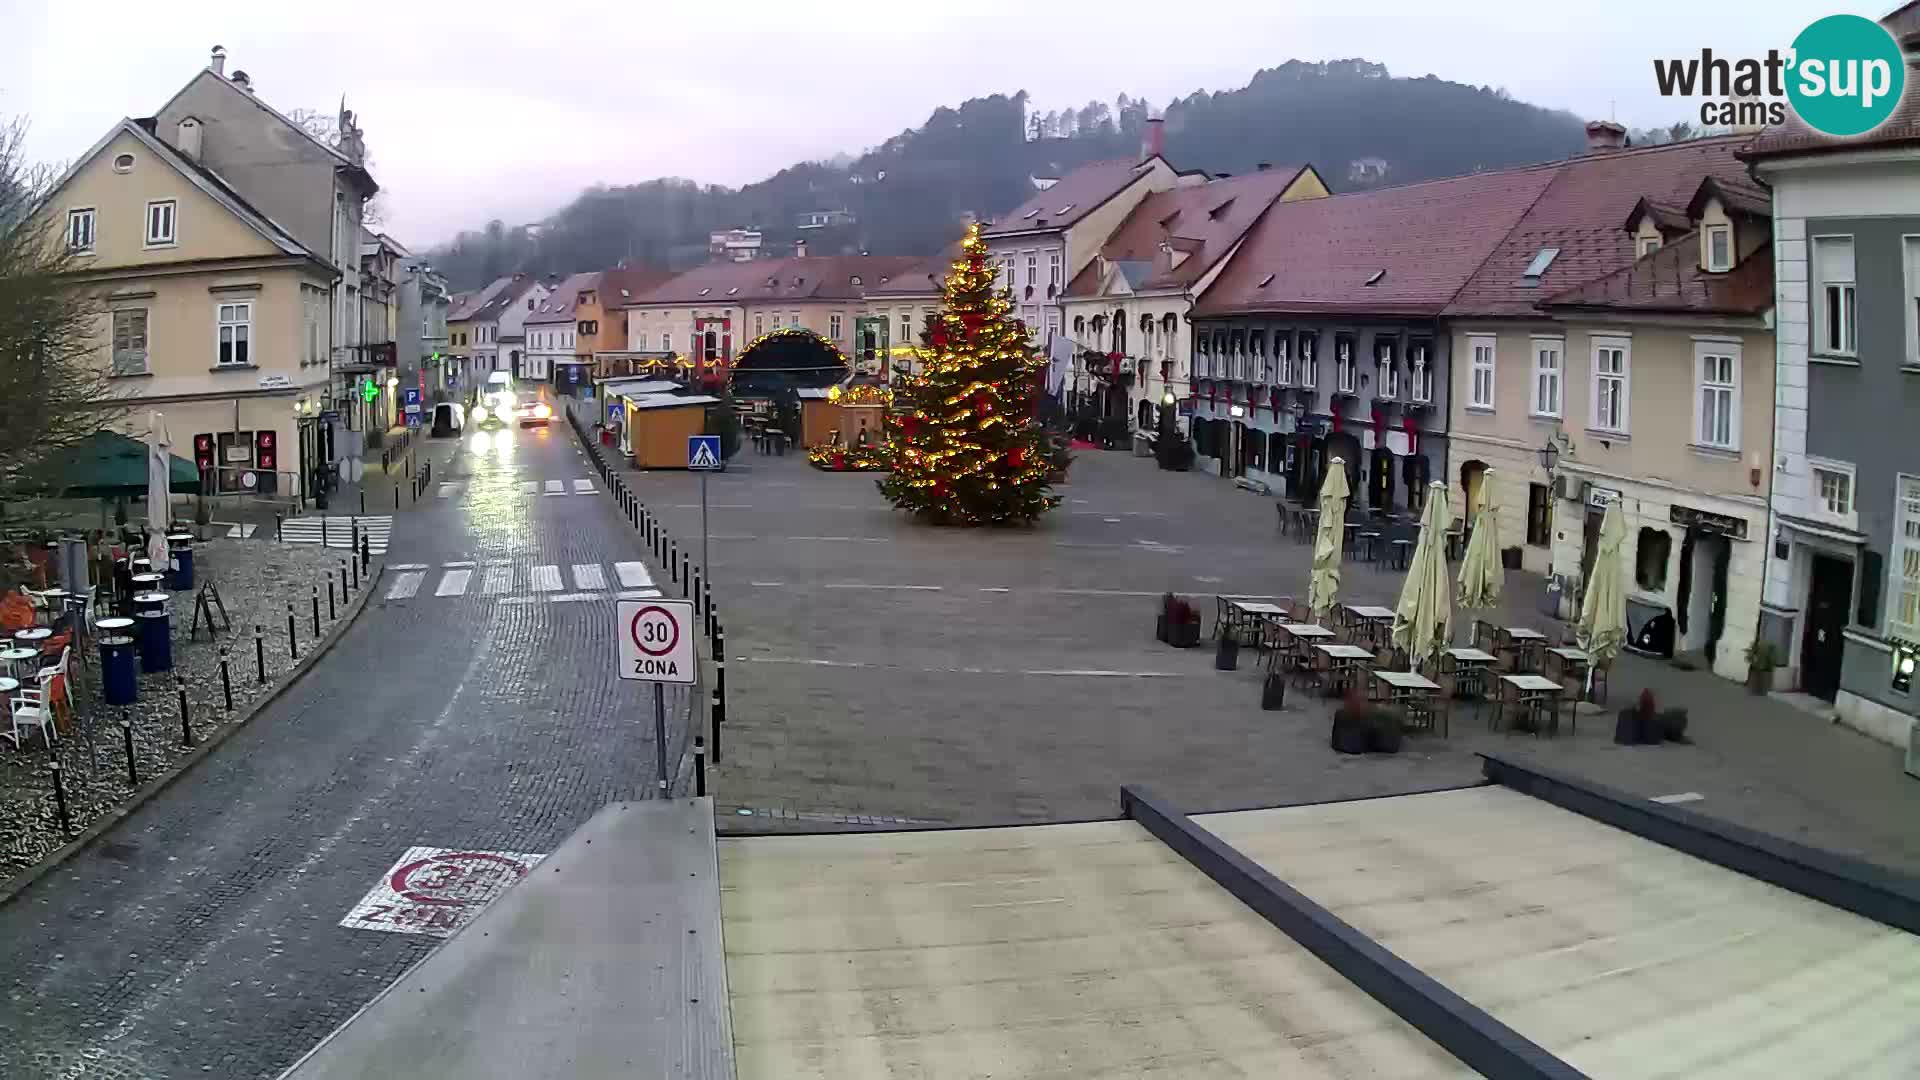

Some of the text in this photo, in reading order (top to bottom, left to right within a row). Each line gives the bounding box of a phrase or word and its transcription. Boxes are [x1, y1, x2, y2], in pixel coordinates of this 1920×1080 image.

[408, 391, 416, 402] P
[643, 621, 668, 643] 30
[634, 659, 678, 676] ZONA
